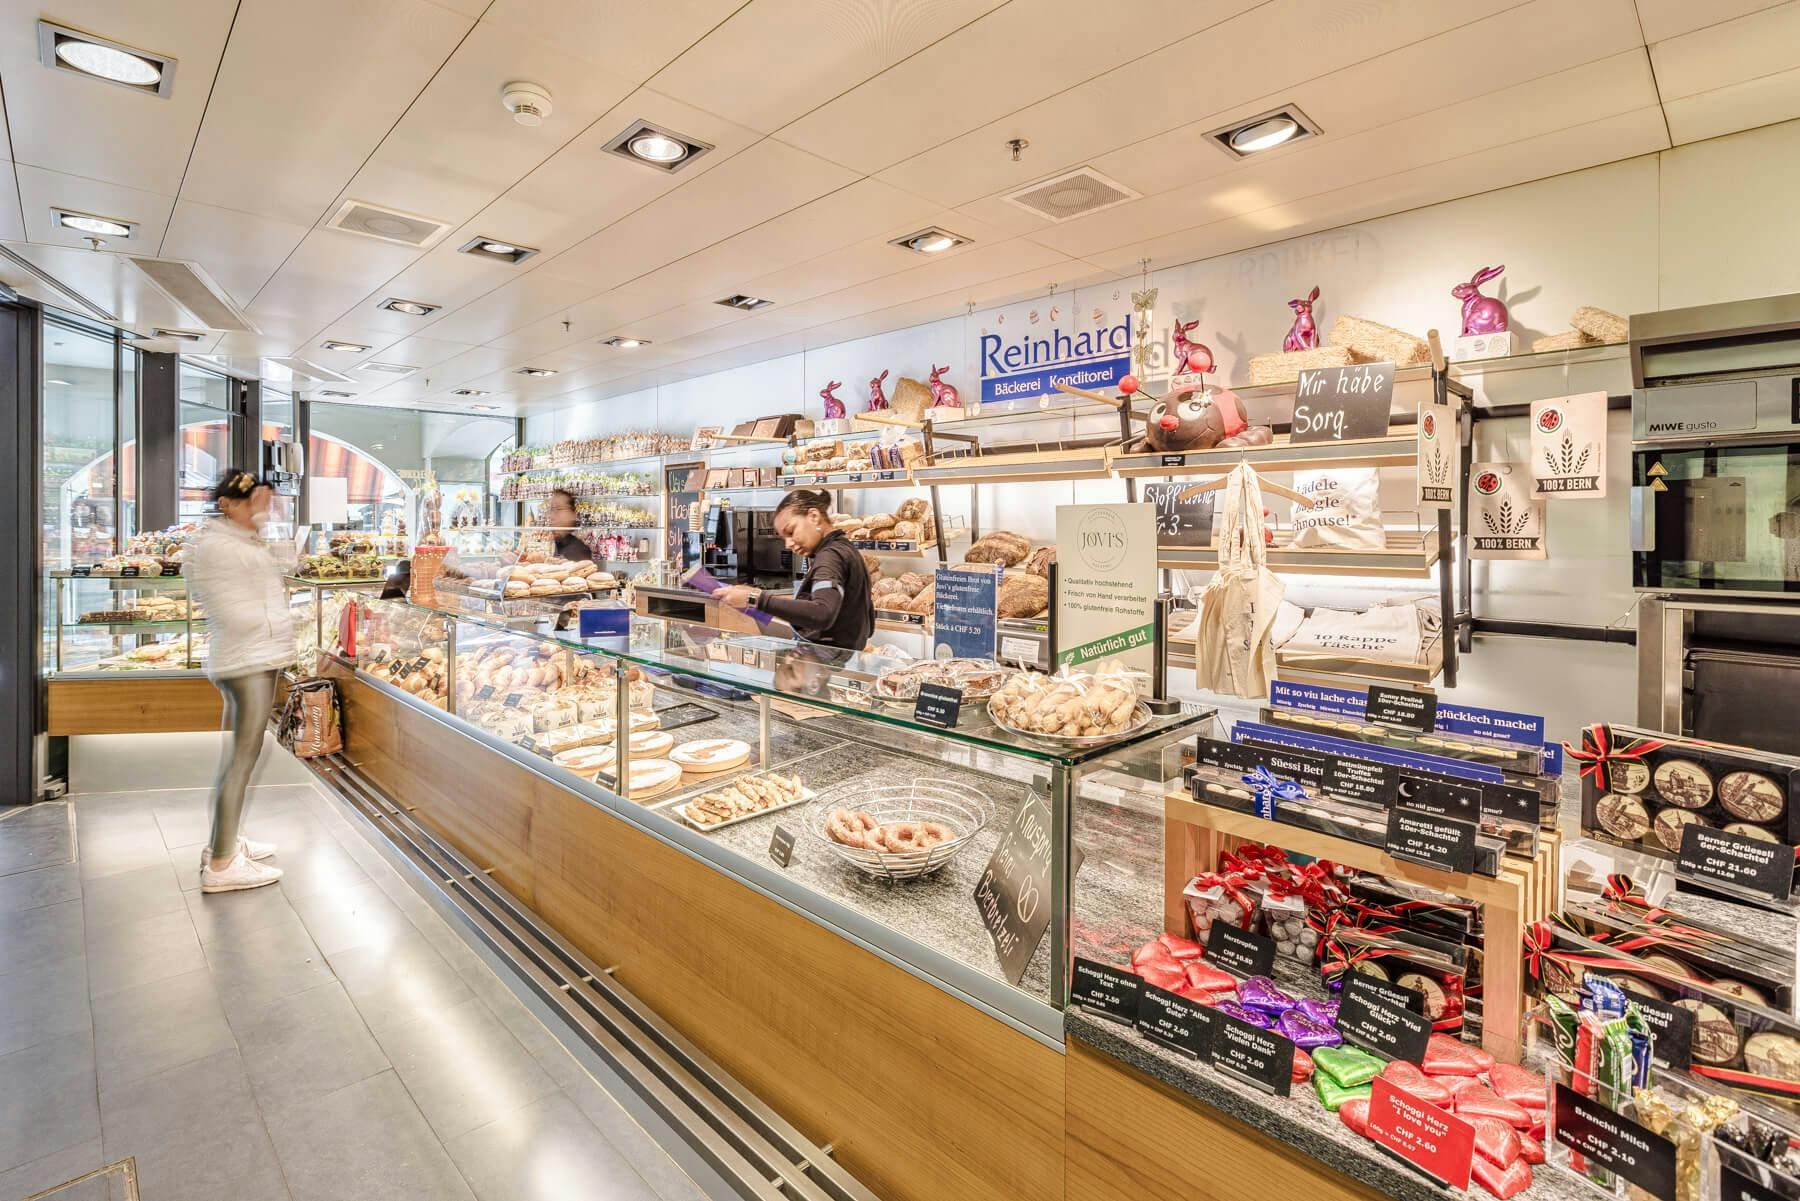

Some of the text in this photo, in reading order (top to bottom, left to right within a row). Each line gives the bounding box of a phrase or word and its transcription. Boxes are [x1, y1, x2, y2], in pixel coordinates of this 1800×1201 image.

[980, 313, 1132, 378] Reinhard
[995, 367, 1114, 396] Bäckerei Konditorei
[1298, 366, 1385, 398] Mir häbe
[1649, 421, 1718, 432] MIWE gusto
[1543, 477, 1592, 491] 100% BERN
[1480, 538, 1532, 549] 100% BERN
[1095, 579, 1133, 588] hochstehend
[1098, 592, 1113, 600] Hand
[1114, 594, 1147, 602] verarbeitet
[1115, 606, 1145, 616] Rohstoffe
[955, 624, 968, 632] CHF
[1080, 629, 1148, 659] Natürlich gut
[1275, 686, 1291, 696] Mit
[1292, 689, 1303, 697] so
[1304, 690, 1318, 700] viu
[1320, 692, 1345, 703] lache
[1436, 709, 1538, 732] glücklech mache!
[1270, 756, 1301, 772] Süessi
[1347, 767, 1372, 777] Truffes
[1333, 770, 1385, 786] 10er-Schachtel
[1340, 781, 1355, 789] CHF
[1399, 816, 1462, 837] Amaretti gefüllt
[1399, 823, 1460, 843] 10er-Schachtel
[1407, 839, 1449, 854] CHF 14.20
[1697, 832, 1776, 859] Berner Grüessli
[1700, 841, 1770, 865] 6er-Schachtel
[1703, 865, 1717, 873] CHF
[1706, 857, 1758, 877] CHF 21.60
[1223, 932, 1259, 952] Herztropfen
[1223, 949, 1236, 958] CHF
[1077, 965, 1137, 990] Schoggi Herz ohne
[1099, 978, 1114, 989] Text
[1090, 990, 1105, 999] CHF
[1353, 978, 1377, 992] Berner
[1378, 986, 1410, 1003] Grüessli
[1144, 990, 1171, 1007] Schoggi
[1172, 1000, 1188, 1014] Herz
[1349, 991, 1380, 1012] Schoggi
[1380, 1007, 1400, 1023] Herz
[1158, 1018, 1189, 1038] CHF 2.60
[1224, 1023, 1276, 1051] Schoggi Herz
[1360, 1020, 1397, 1044] CHF 2.60
[1229, 1050, 1265, 1070] CHF 2.60
[1389, 1094, 1450, 1132] Schoggi Herz
[1403, 1110, 1423, 1127] love
[1574, 1105, 1651, 1152] Branchli Milch
[1390, 1134, 1403, 1144] CHF
[1396, 1125, 1437, 1154] CHF 2.60
[1559, 1127, 1576, 1143] 100g
[1582, 1141, 1597, 1153] CHF
[1586, 1133, 1636, 1166] CHF 2.10
